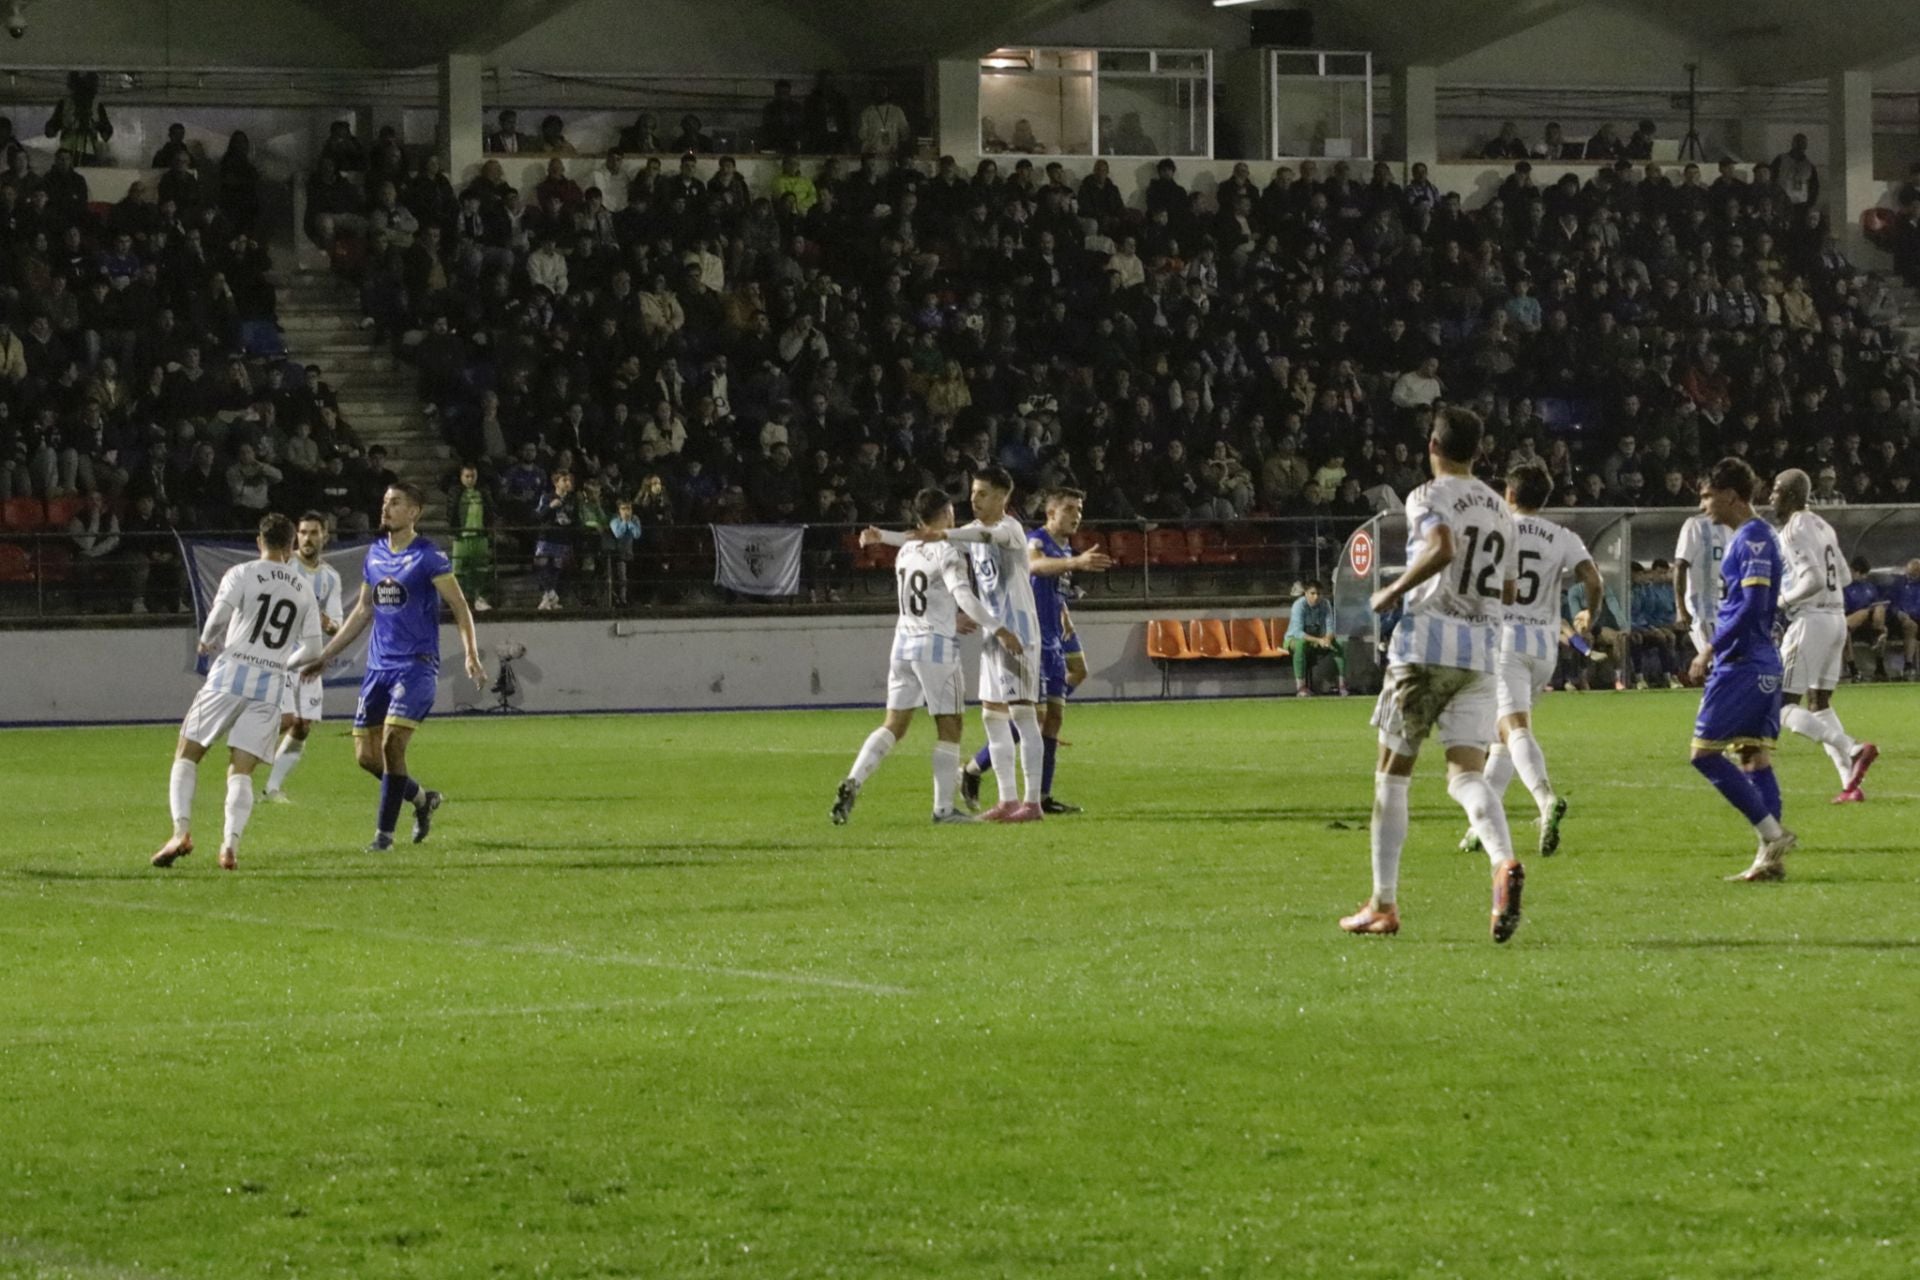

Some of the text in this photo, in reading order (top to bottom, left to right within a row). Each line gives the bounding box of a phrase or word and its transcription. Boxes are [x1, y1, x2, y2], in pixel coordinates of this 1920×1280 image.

[1518, 524, 1554, 543] REINA
[257, 570, 303, 592] A. FORÉS
[1458, 525, 1505, 599] 12
[1516, 550, 1541, 605] 5
[1825, 544, 1837, 593] 6
[898, 567, 928, 617] 18
[248, 593, 298, 650] 19
